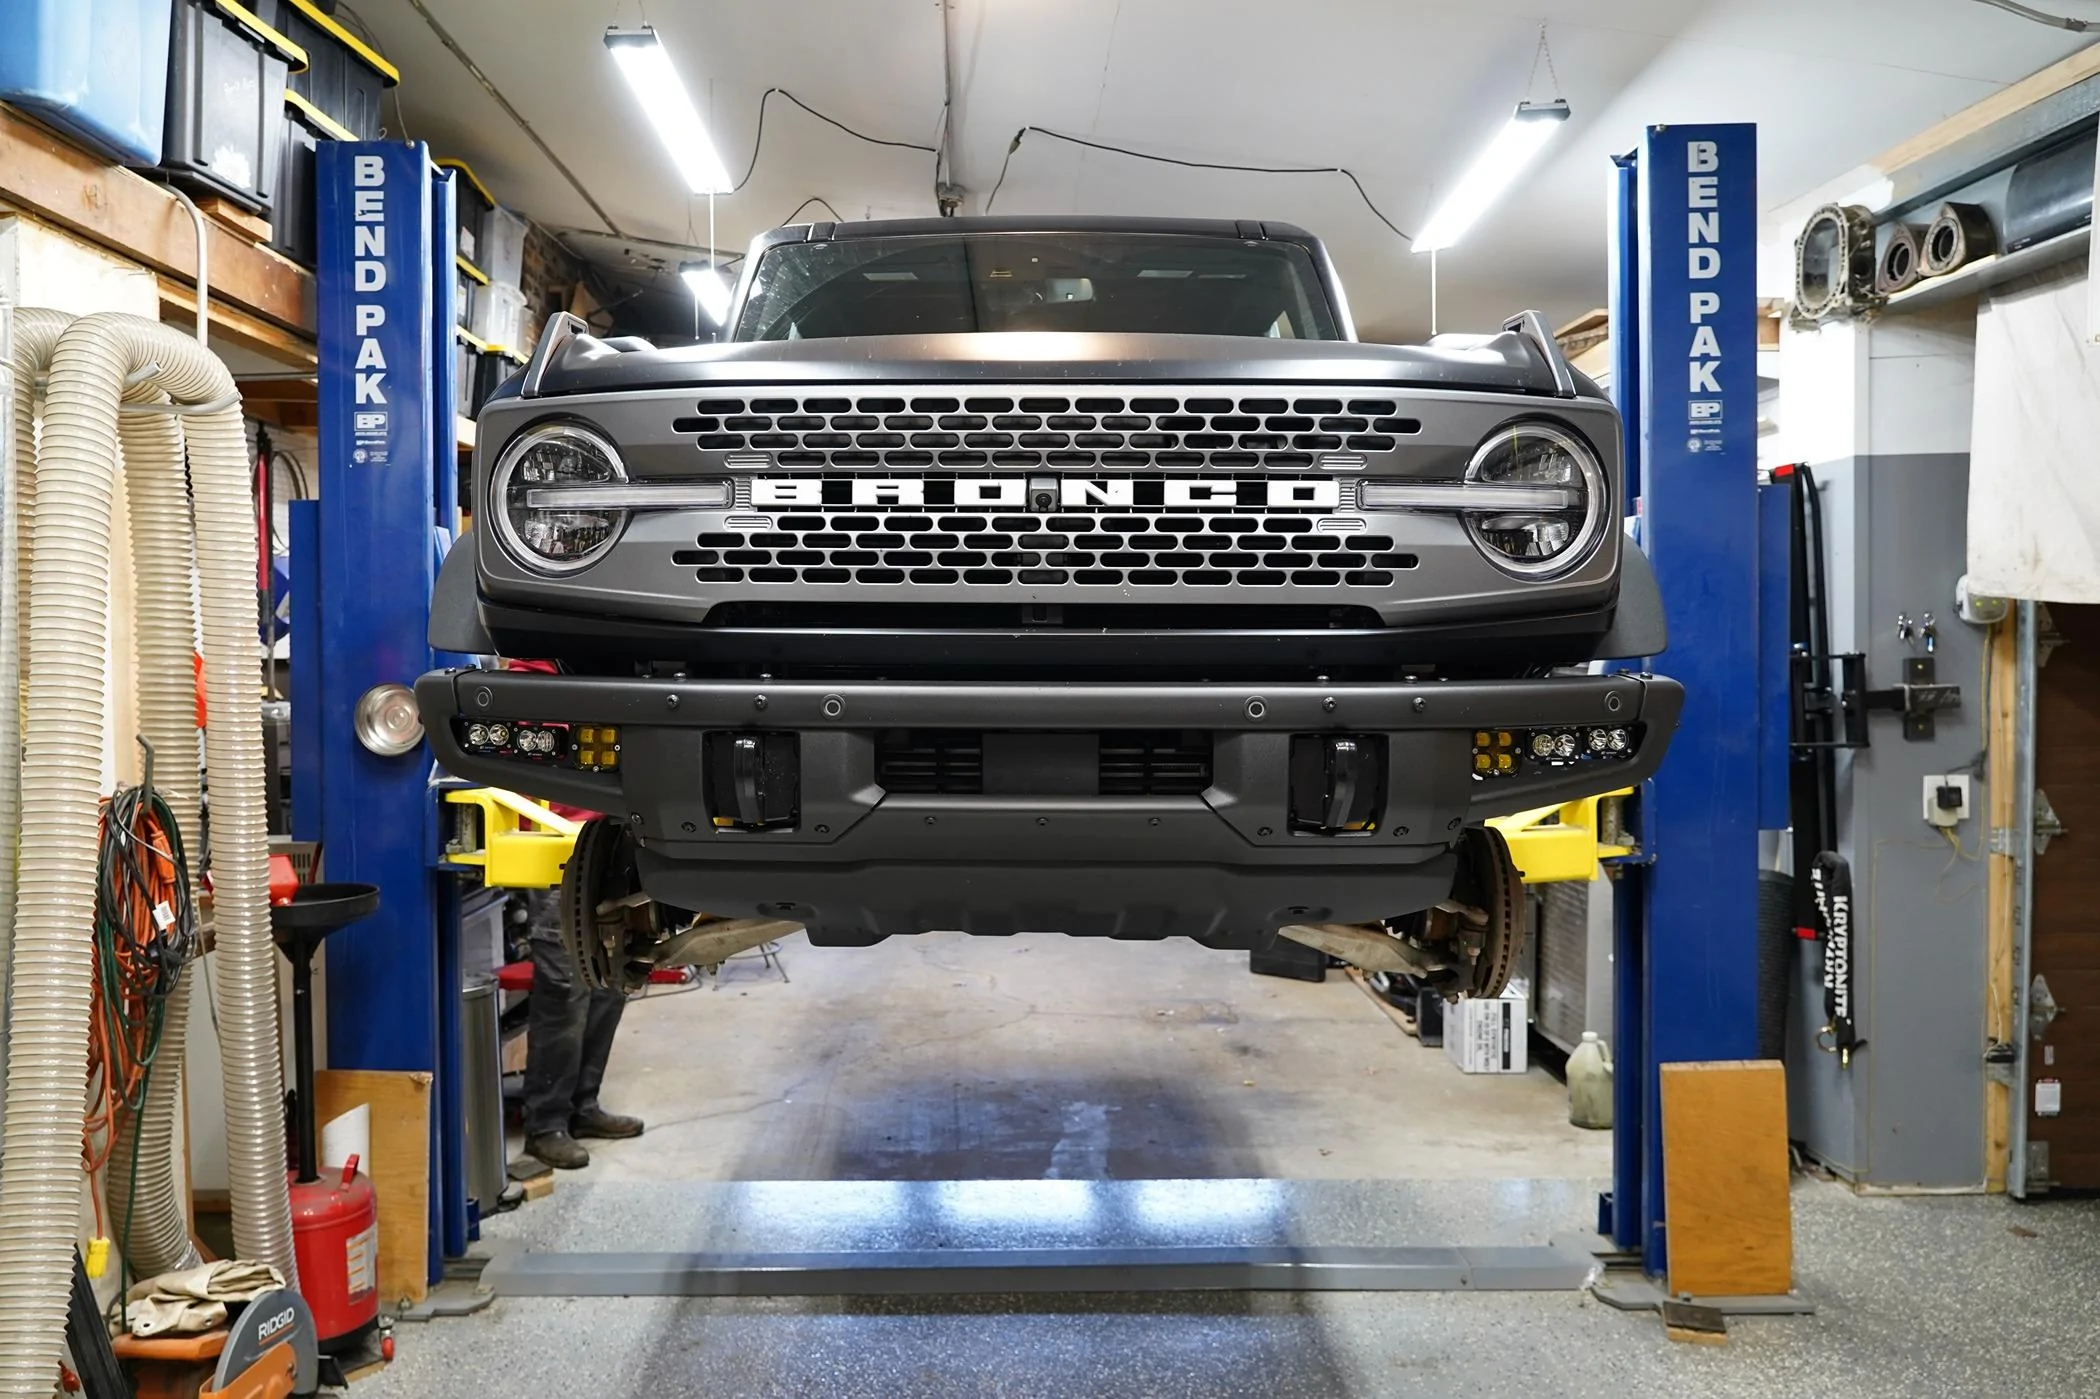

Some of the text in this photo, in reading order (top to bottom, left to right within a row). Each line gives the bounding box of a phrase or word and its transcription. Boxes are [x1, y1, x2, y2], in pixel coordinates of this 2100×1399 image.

[354, 155, 387, 292] BEND
[1687, 141, 1721, 279] BEND
[355, 305, 388, 404] PAK
[1689, 292, 1722, 393] PAK
[356, 414, 386, 429] BP
[1691, 402, 1720, 418] BP
[750, 478, 1340, 507] BRONCO
[258, 1307, 295, 1340] RIDGID
